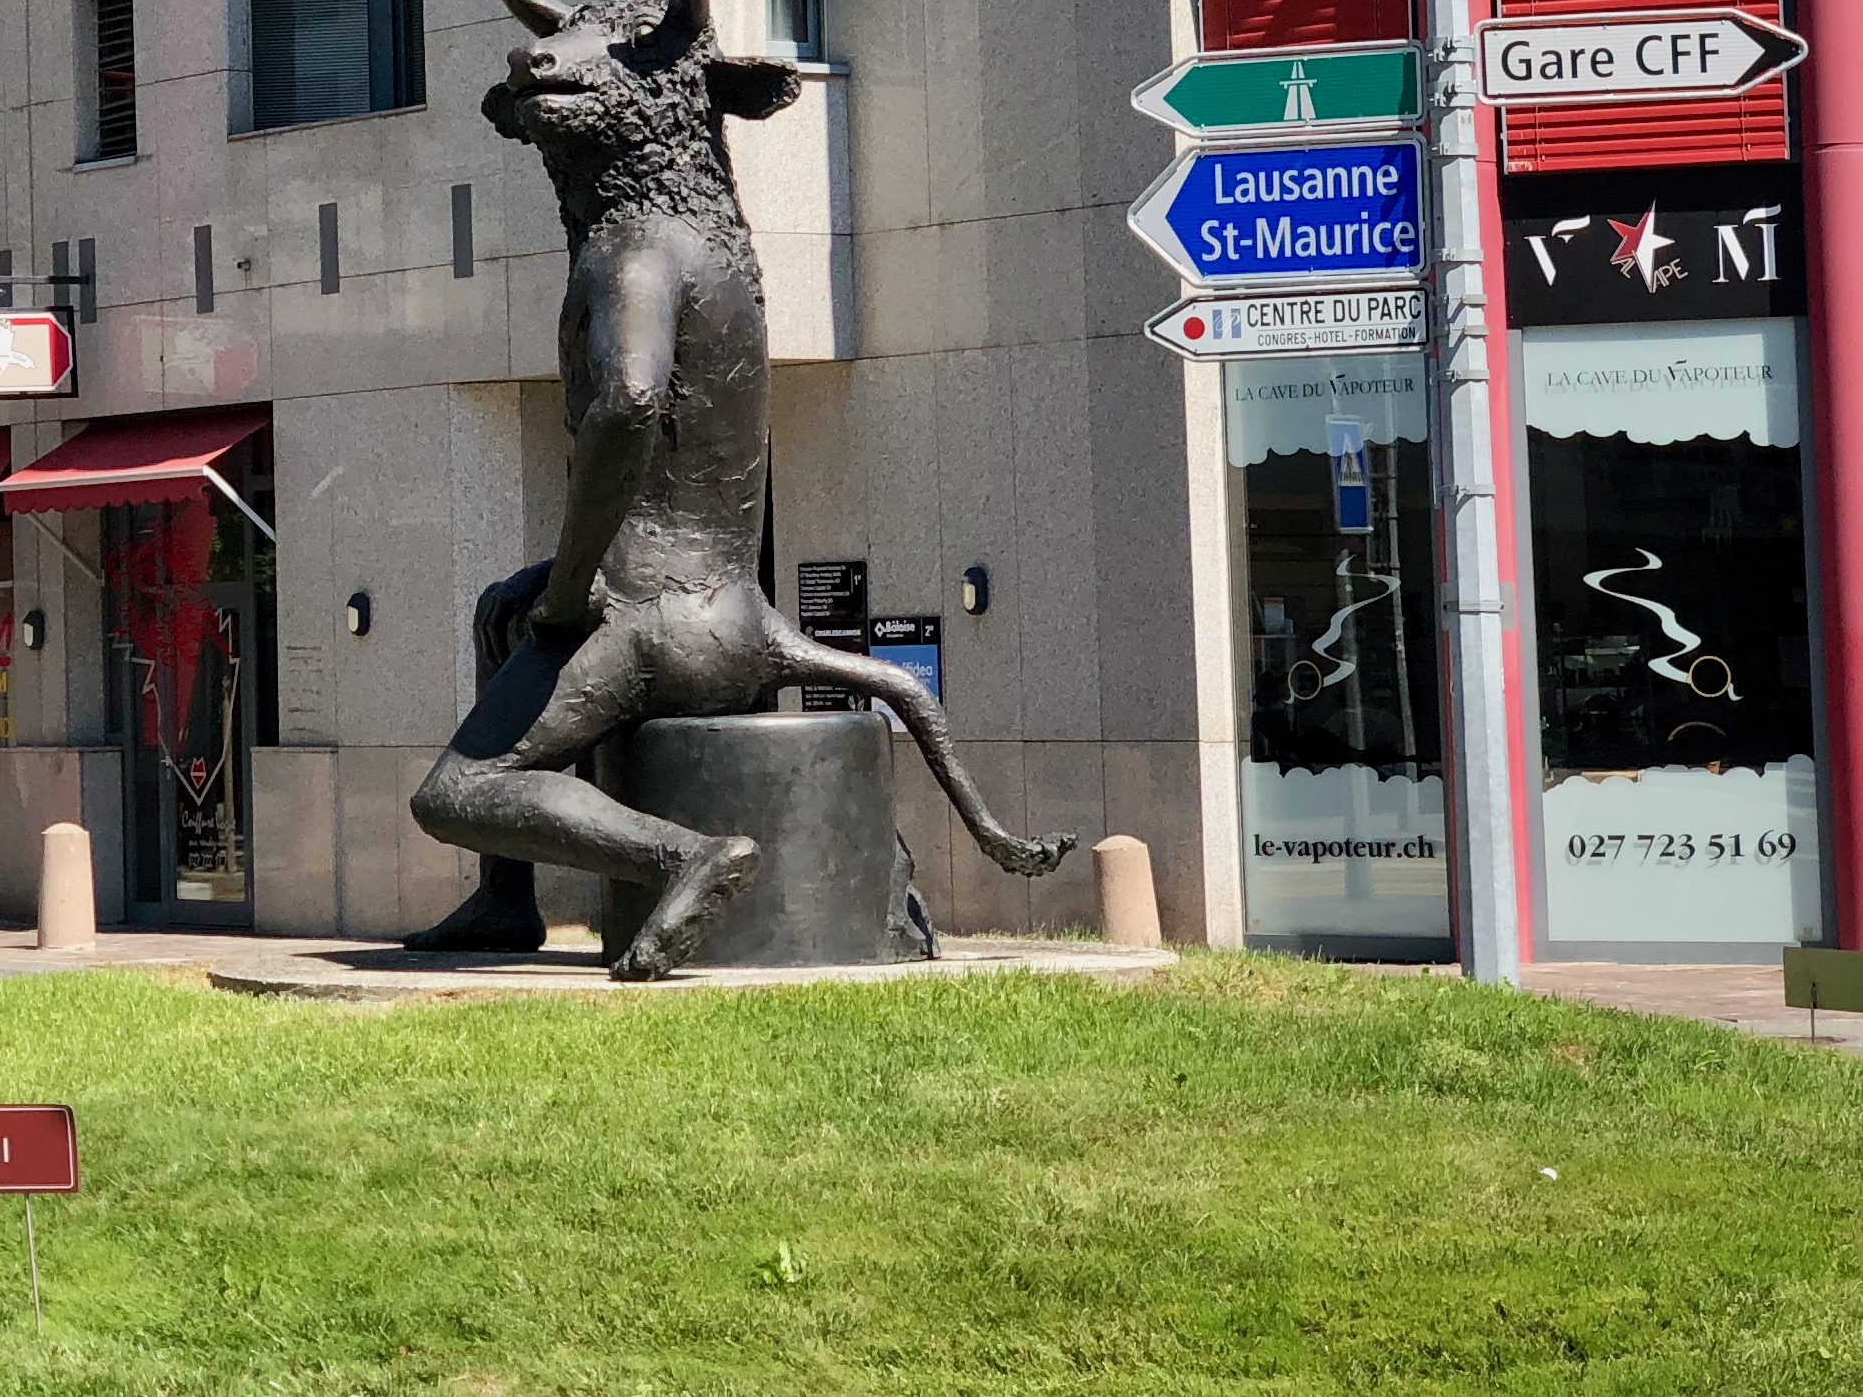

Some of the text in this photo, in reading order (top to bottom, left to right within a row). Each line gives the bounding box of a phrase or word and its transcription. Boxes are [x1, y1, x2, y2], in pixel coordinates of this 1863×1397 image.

[1500, 33, 1720, 82] Gare CFF
[1214, 163, 1399, 205] Lausanne
[1200, 211, 1416, 263] St-Maurice
[1246, 294, 1422, 328] CENTRE DU PARC
[1235, 374, 1415, 402] LA CAVE DU VAPOTEUR
[1547, 359, 1774, 387] LA CAVE DU VAPOTEUR
[1252, 833, 1436, 865] le-vapoteur.ch
[1568, 829, 1797, 861] 027 723 51 69
